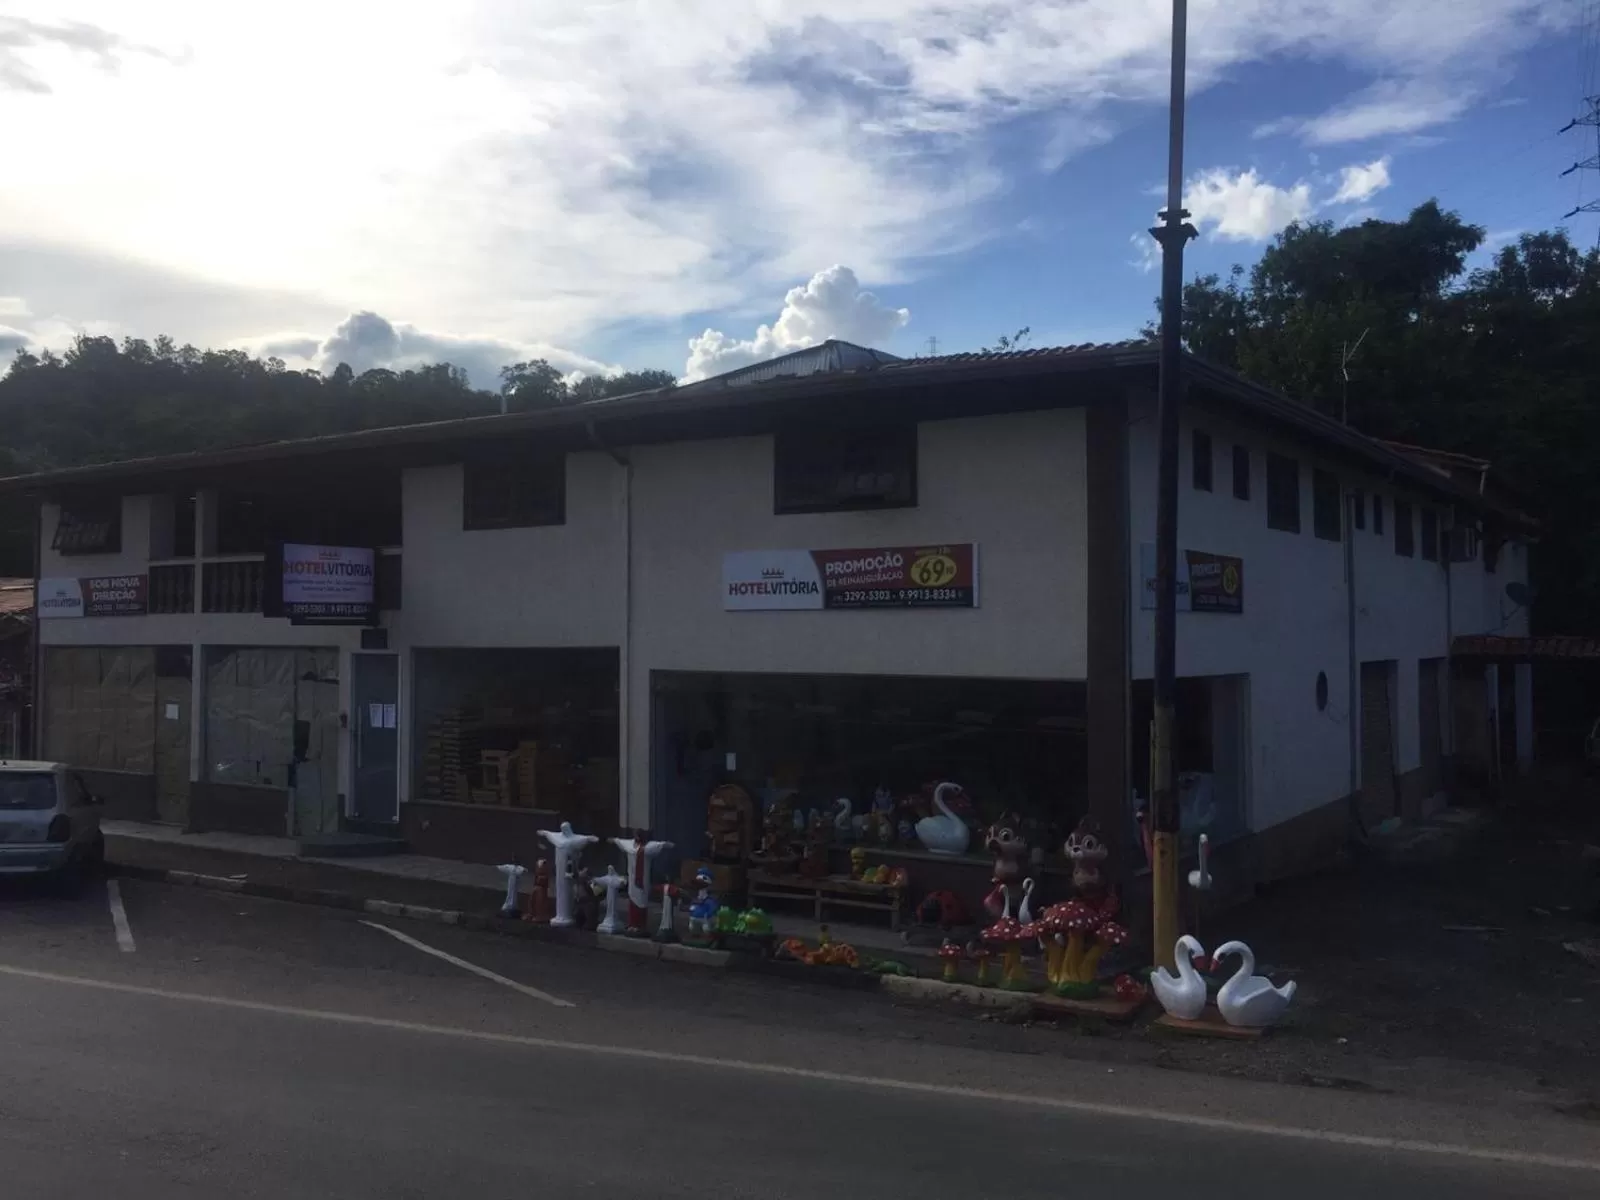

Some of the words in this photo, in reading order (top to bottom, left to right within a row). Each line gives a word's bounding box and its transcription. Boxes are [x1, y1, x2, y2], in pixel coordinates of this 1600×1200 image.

[283, 560, 373, 577] HOTELVITÓRIA
[825, 552, 904, 575] PROMOÇÃO
[919, 557, 946, 584] 69
[111, 576, 140, 588] NOVA
[728, 576, 820, 595] HOTELVITÓRIA
[91, 588, 137, 602] DIREÇÃO
